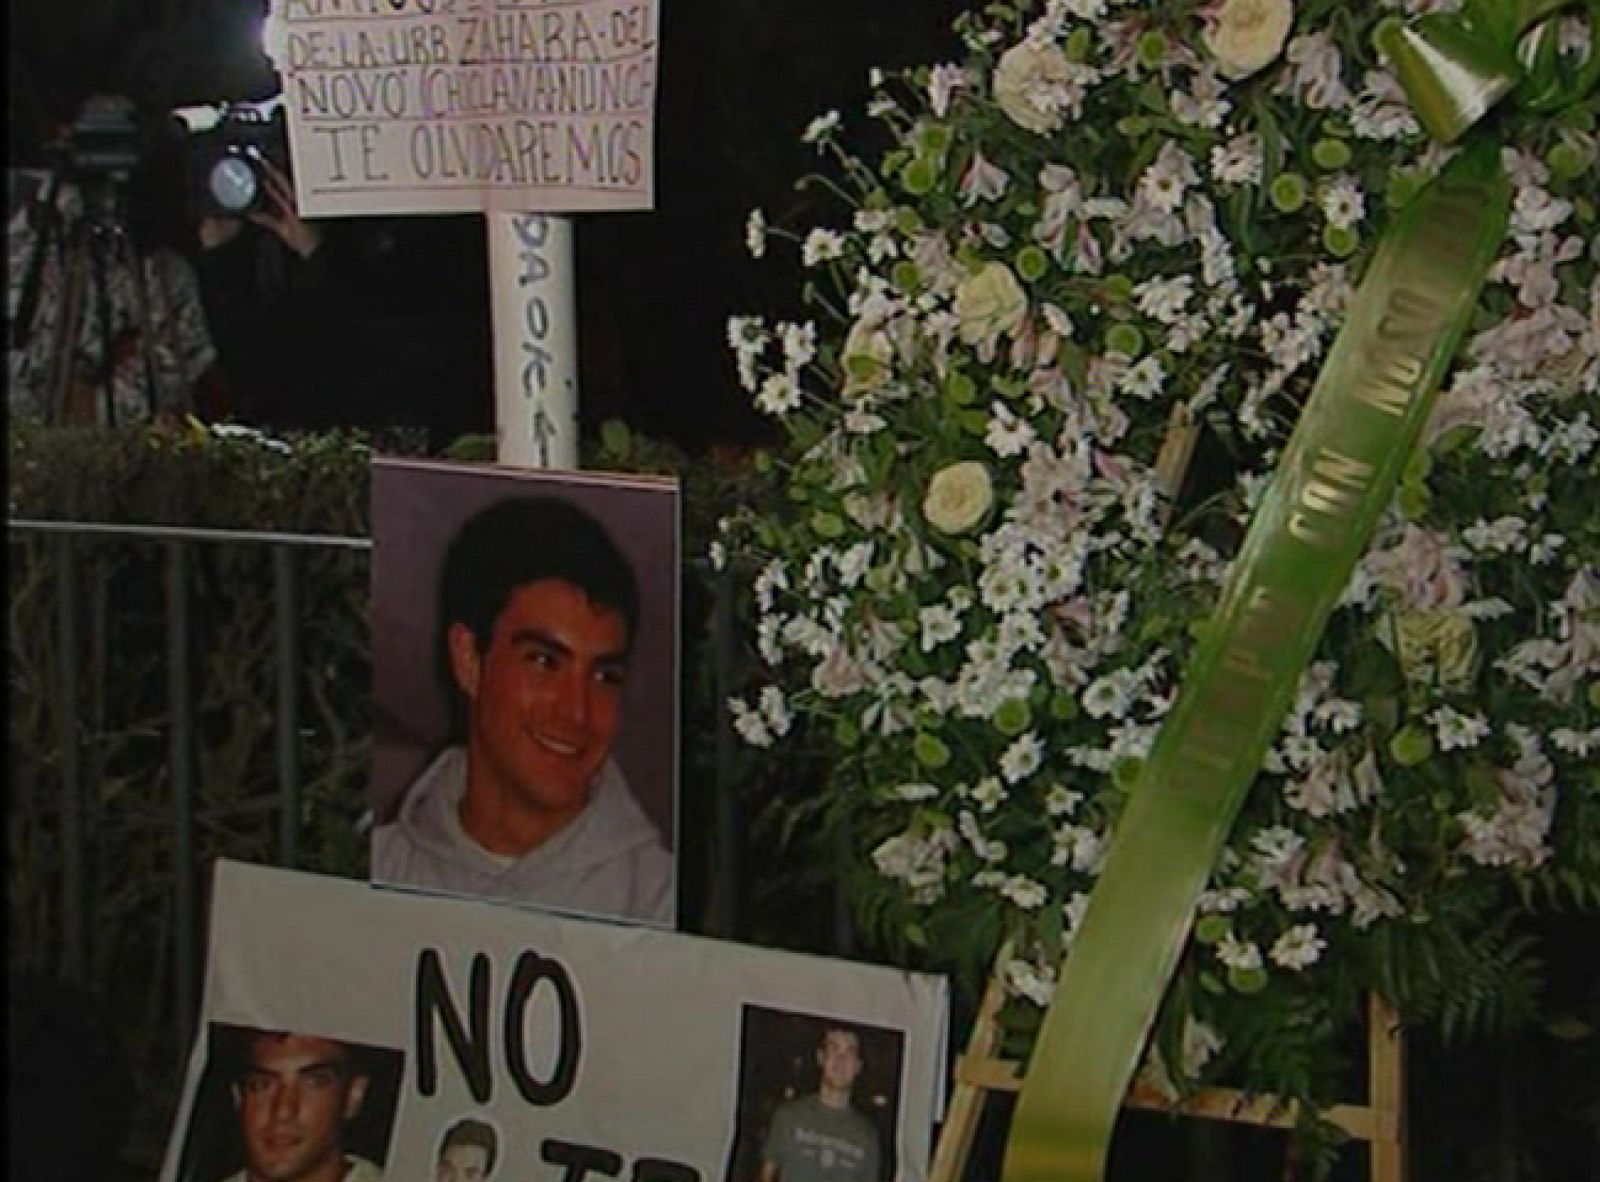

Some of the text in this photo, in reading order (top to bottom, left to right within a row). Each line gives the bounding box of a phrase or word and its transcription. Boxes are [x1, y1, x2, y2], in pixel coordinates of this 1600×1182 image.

[297, 68, 407, 119] NOVO
[312, 124, 389, 182] TE
[1287, 446, 1375, 547] CON
[415, 947, 582, 1106] NO
